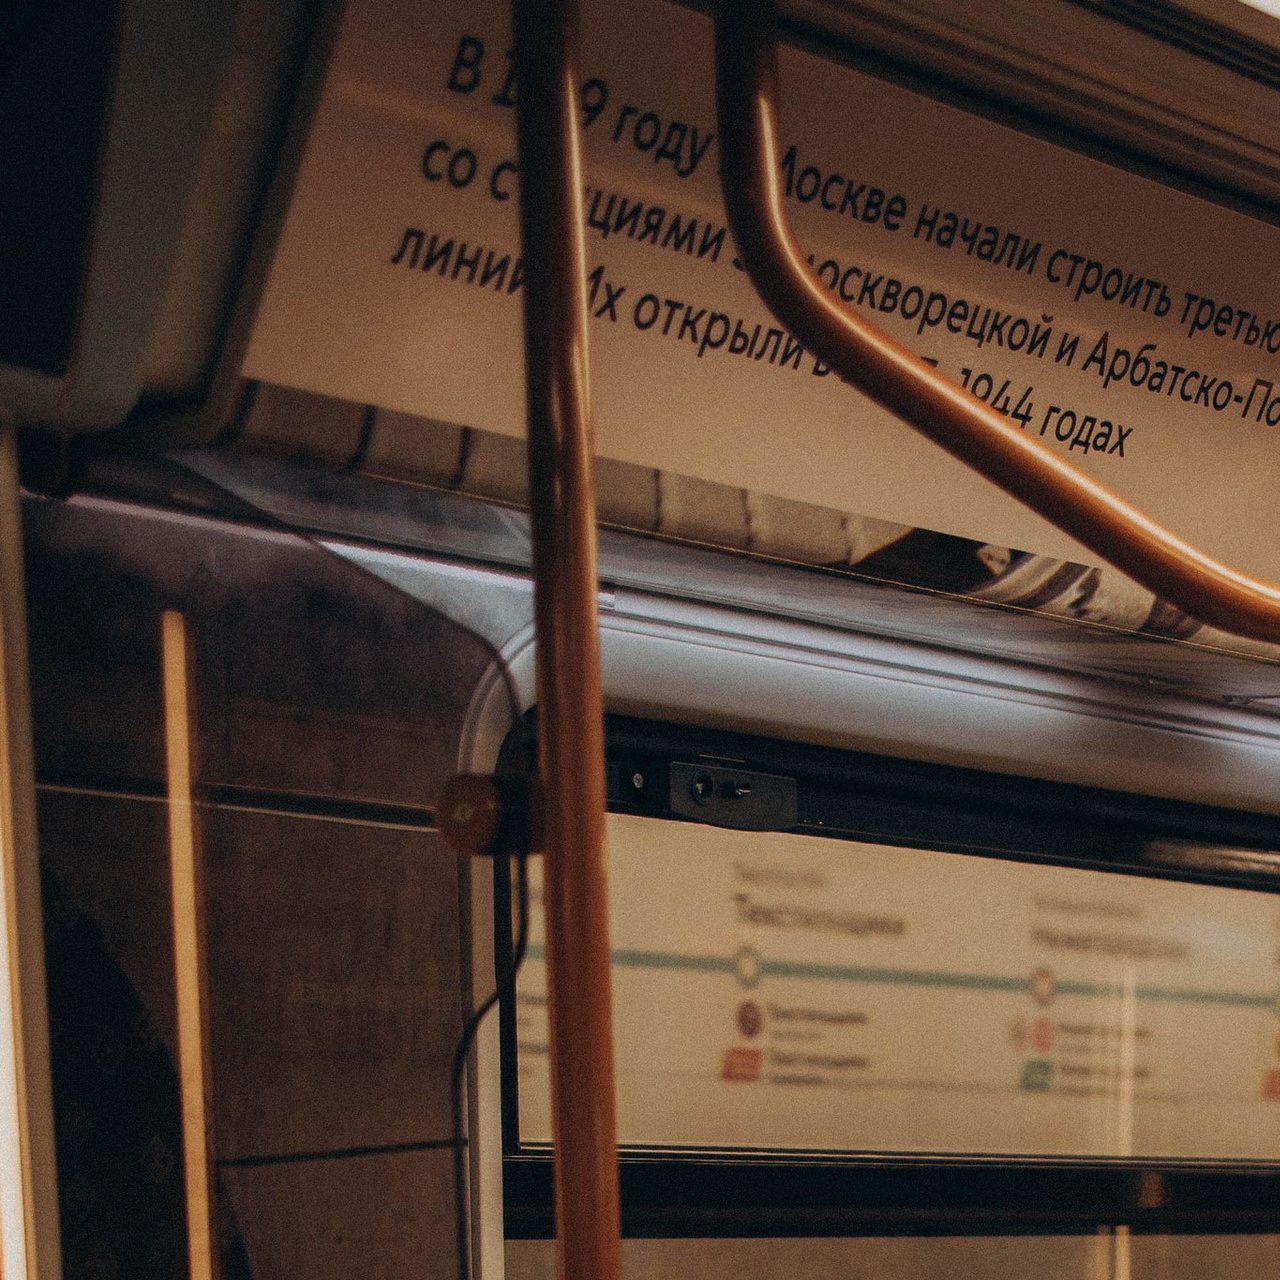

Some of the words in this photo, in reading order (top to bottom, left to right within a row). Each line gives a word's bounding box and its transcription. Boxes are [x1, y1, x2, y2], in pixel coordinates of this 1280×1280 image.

[421, 139, 488, 189] со
[488, 160, 727, 263] сциями
[732, 254, 1055, 359] оскворецкой
[1053, 332, 1080, 367] и
[447, 34, 485, 93] В
[612, 103, 714, 178] году
[912, 204, 1043, 275] начали
[1045, 248, 1172, 318] строить
[632, 293, 806, 371] открыли
[1039, 405, 1134, 458] годах
